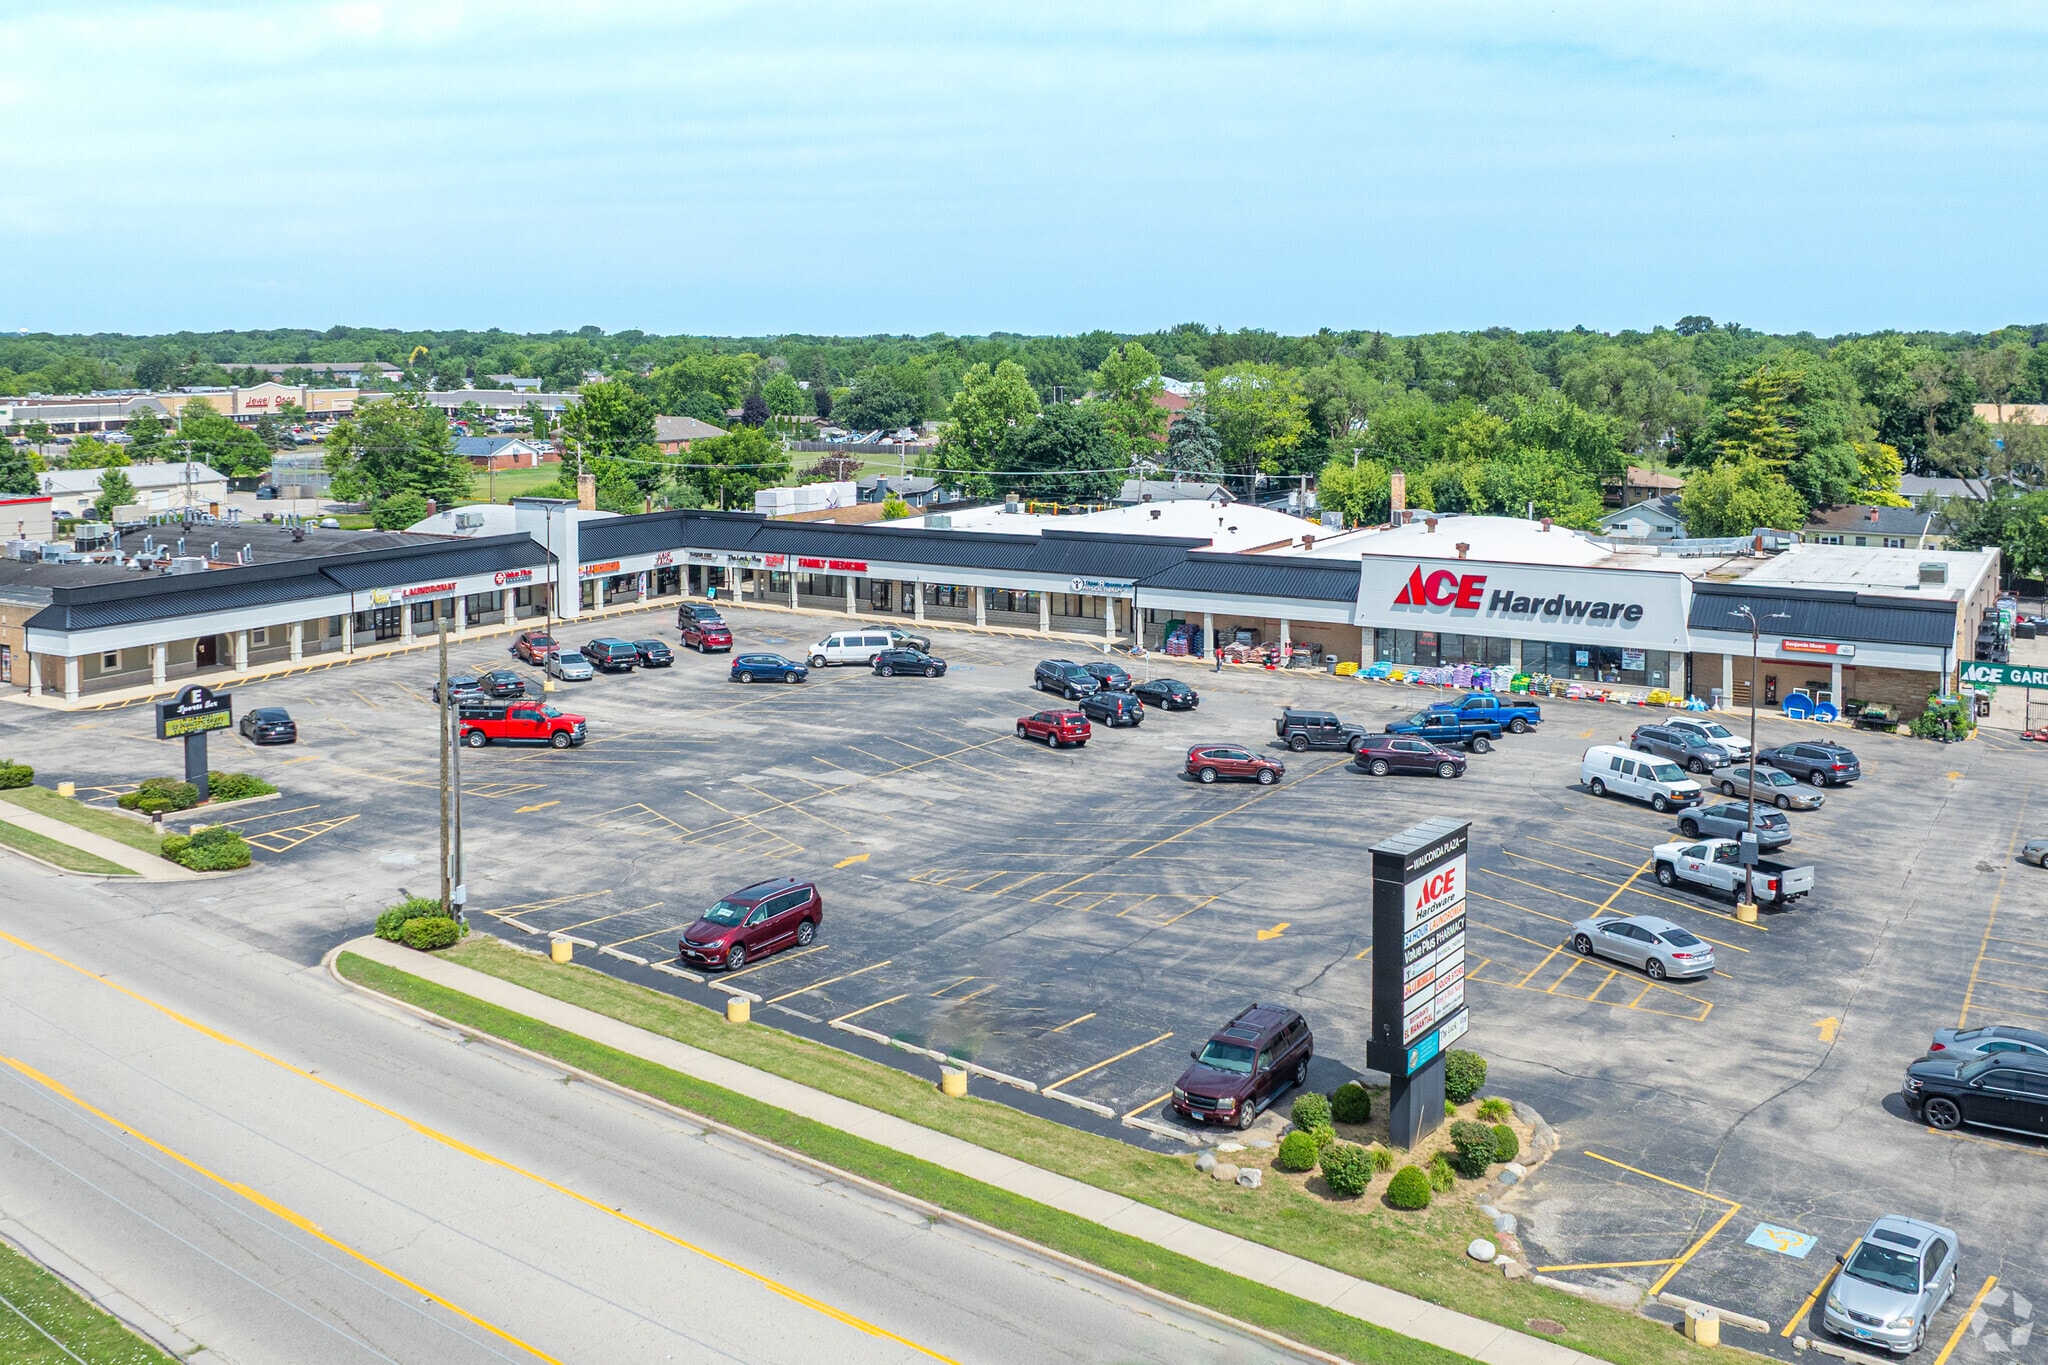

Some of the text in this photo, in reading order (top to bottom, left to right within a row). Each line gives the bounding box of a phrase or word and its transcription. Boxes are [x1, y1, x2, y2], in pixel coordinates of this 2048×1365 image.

[246, 395, 296, 405] Jewel Osco
[798, 558, 868, 572] FAMILY MEDICINE
[403, 583, 457, 597] LAUNDROMAT
[1393, 564, 1487, 609] ACE
[1489, 590, 1643, 621] Hardware
[1961, 664, 2004, 682] ACE
[191, 689, 202, 703] E
[177, 704, 203, 715] Sports
[1413, 838, 1460, 870] WAUCONDA PLAZA
[1416, 867, 1456, 910] ACE
[1416, 894, 1455, 921] Hardware
[1405, 902, 1464, 947] 24 HOUR LAUNDROMAT
[1404, 917, 1465, 964] Value Plus PHARMACY
[1436, 975, 1451, 991] LIQUOR
[1451, 965, 1464, 980] STORE
[1404, 1029, 1410, 1040] EL
